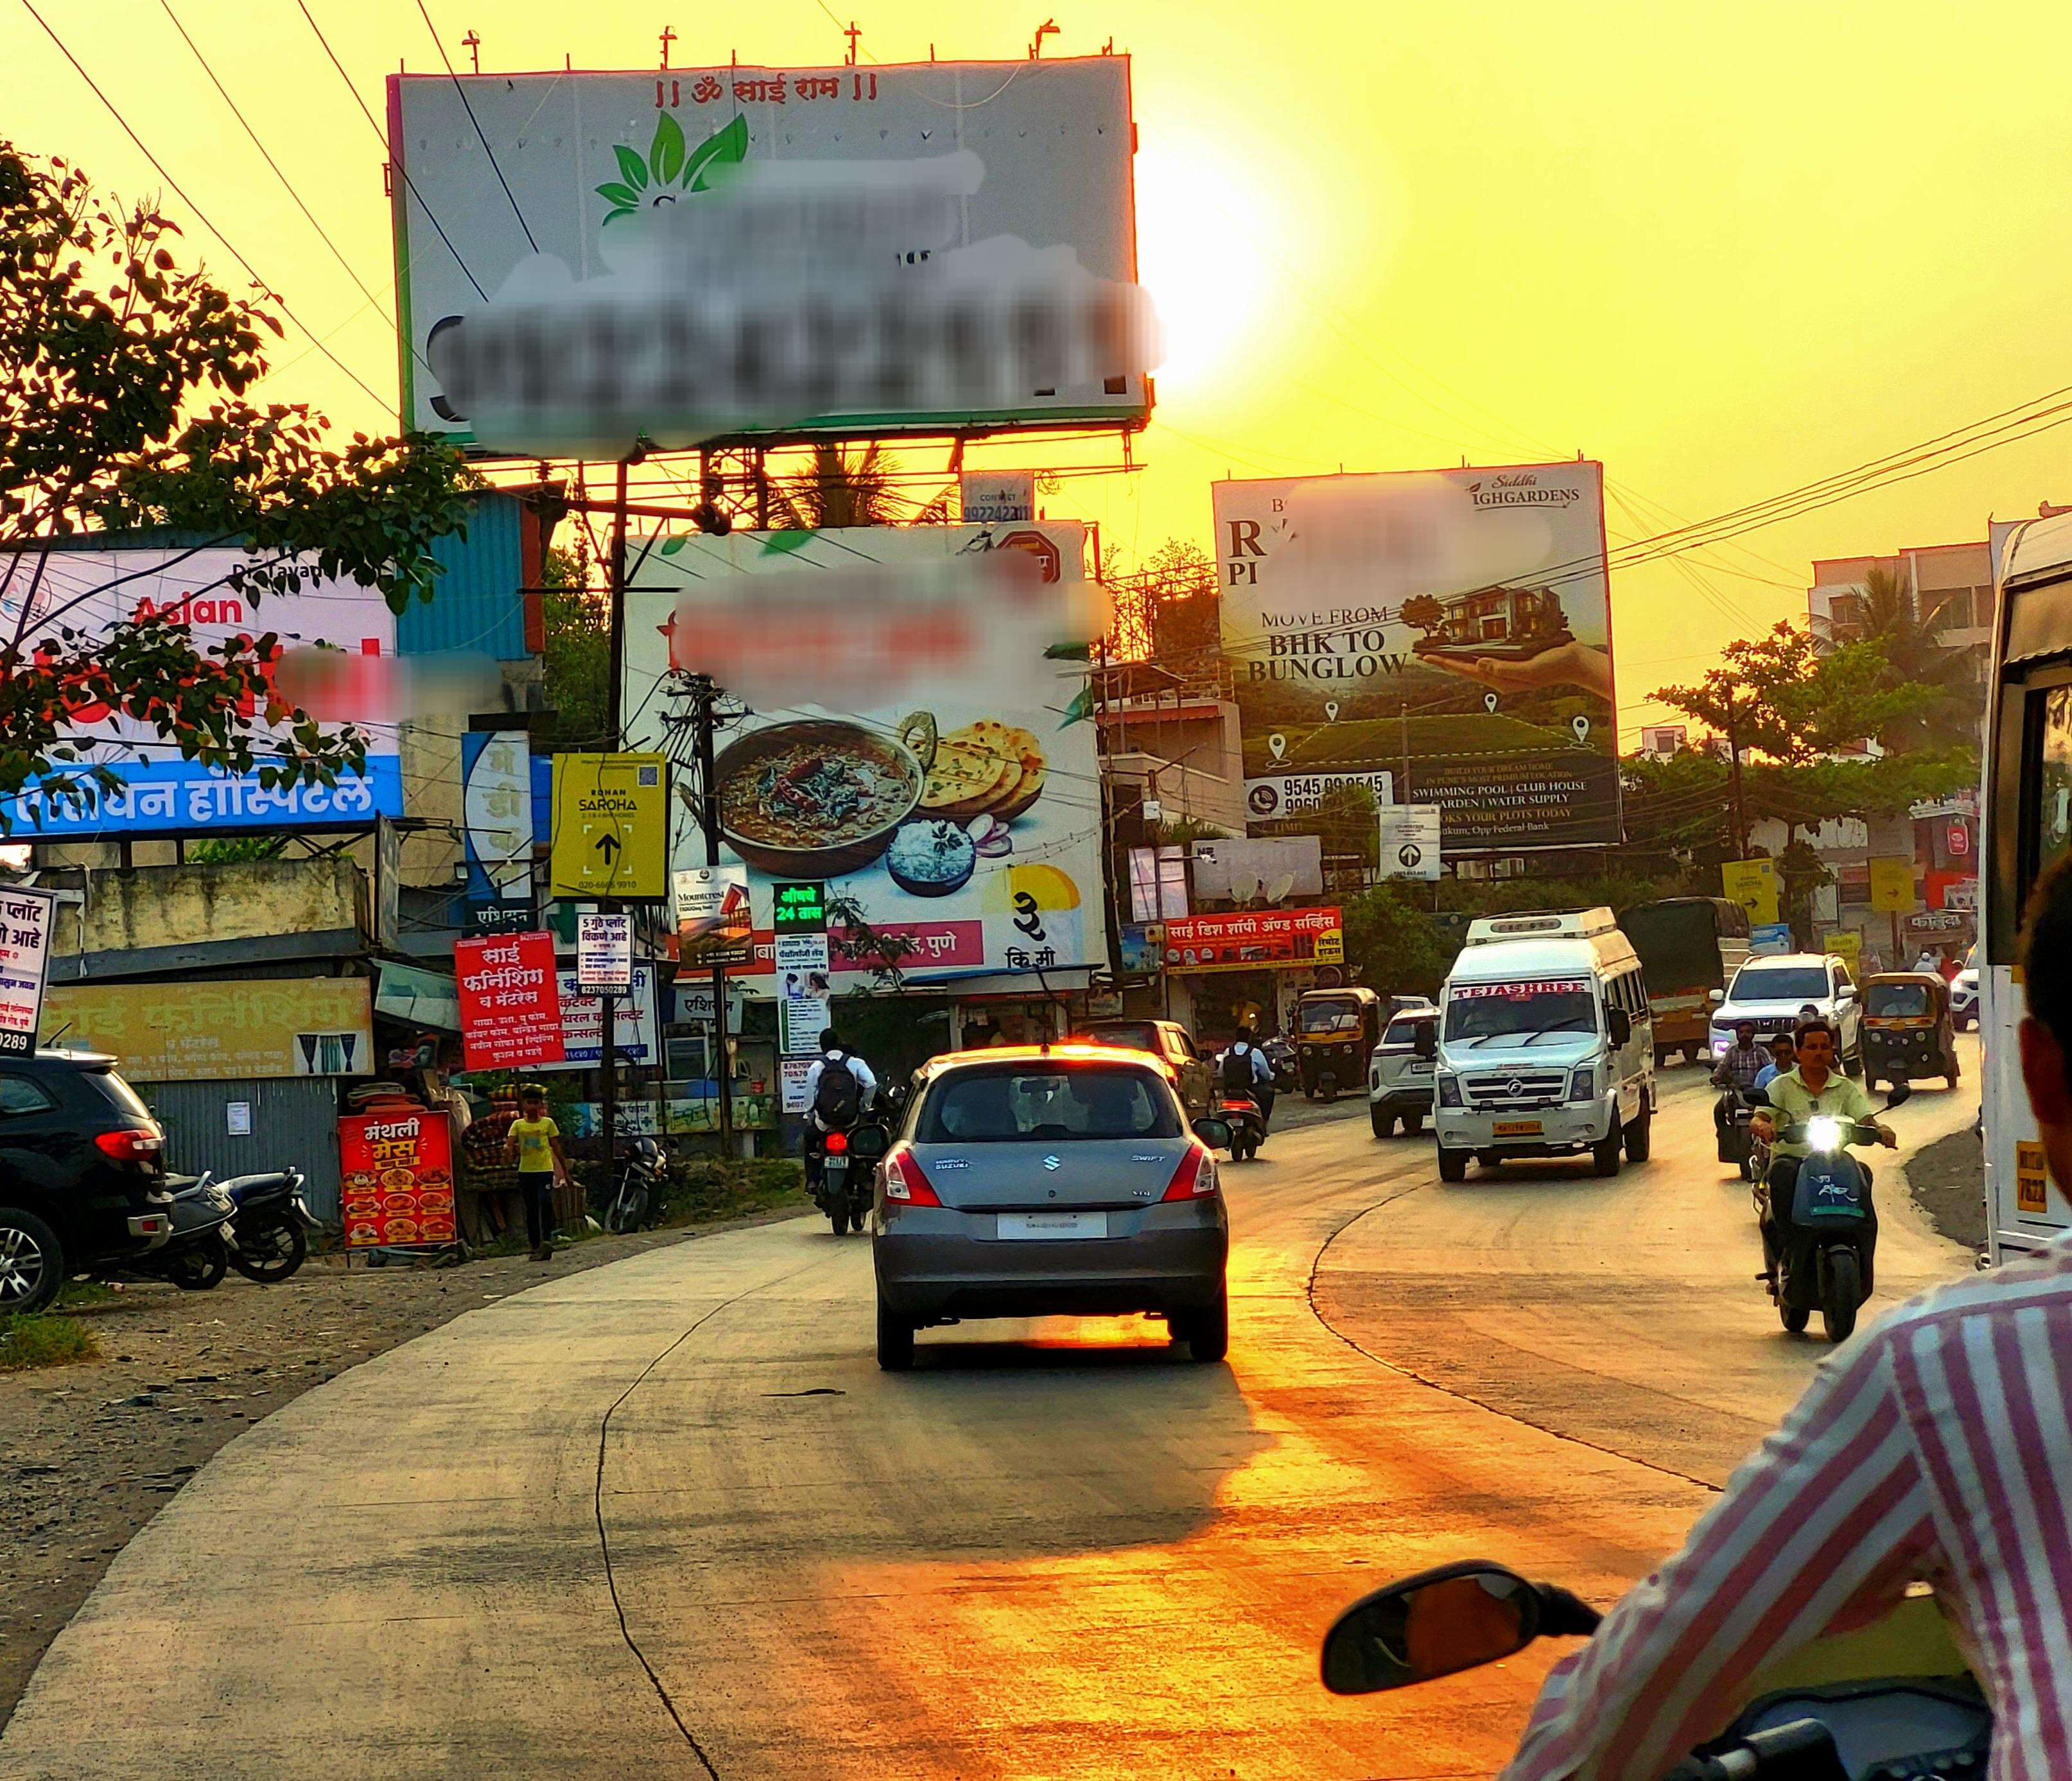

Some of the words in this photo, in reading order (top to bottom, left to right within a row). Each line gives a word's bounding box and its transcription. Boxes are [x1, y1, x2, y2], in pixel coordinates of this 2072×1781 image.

[692, 76, 723, 104] ॐ
[732, 73, 787, 104] साई
[794, 76, 840, 100] राम
[1492, 474, 1537, 489] Siddhi
[133, 591, 242, 624] Asian
[1330, 606, 1388, 624] FROM
[1269, 633, 1337, 657] BHK
[1346, 629, 1385, 652] TO
[1248, 652, 1408, 682] BUNGLOW
[1284, 778, 1321, 797] 9545
[1413, 786, 1474, 798] SWIMMING
[1478, 785, 1508, 795] POOL
[1516, 783, 1545, 792] CLUB
[1549, 781, 1587, 790] HOUSE
[579, 799, 638, 811] SAROHA
[1488, 795, 1526, 806] WATER
[1529, 794, 1570, 804] SUPPLY
[1441, 814, 1462, 823] OKS
[1465, 812, 1498, 822] YOUR
[1500, 810, 1532, 821] PLOTS
[1535, 808, 1573, 818] TODAY
[1441, 826, 1471, 835] ukum,
[677, 891, 725, 901] Mountcrest
[6, 899, 44, 923] प्लॉट
[776, 907, 795, 921] 24
[797, 907, 823, 919] तास
[583, 918, 589, 928] 5
[605, 916, 627, 928] प्लॉट
[1169, 921, 1194, 939] साई
[1197, 921, 1223, 936] डिश
[1226, 918, 1257, 935] शॉपी
[1294, 912, 1335, 930] सर्व्हिस
[11, 928, 42, 949] आहे
[582, 930, 608, 941] विकणे
[610, 930, 628, 941] आहे
[926, 931, 956, 958] पुणे
[482, 941, 520, 964] साई
[462, 965, 544, 992] फर्निशिंग
[480, 996, 491, 1008] व
[496, 989, 538, 1007] मॅटरेस
[581, 986, 627, 994] 8237050289
[1454, 982, 1585, 999] TEJASHREE
[364, 1117, 421, 1140] मंथली
[372, 1138, 417, 1159] मेस
